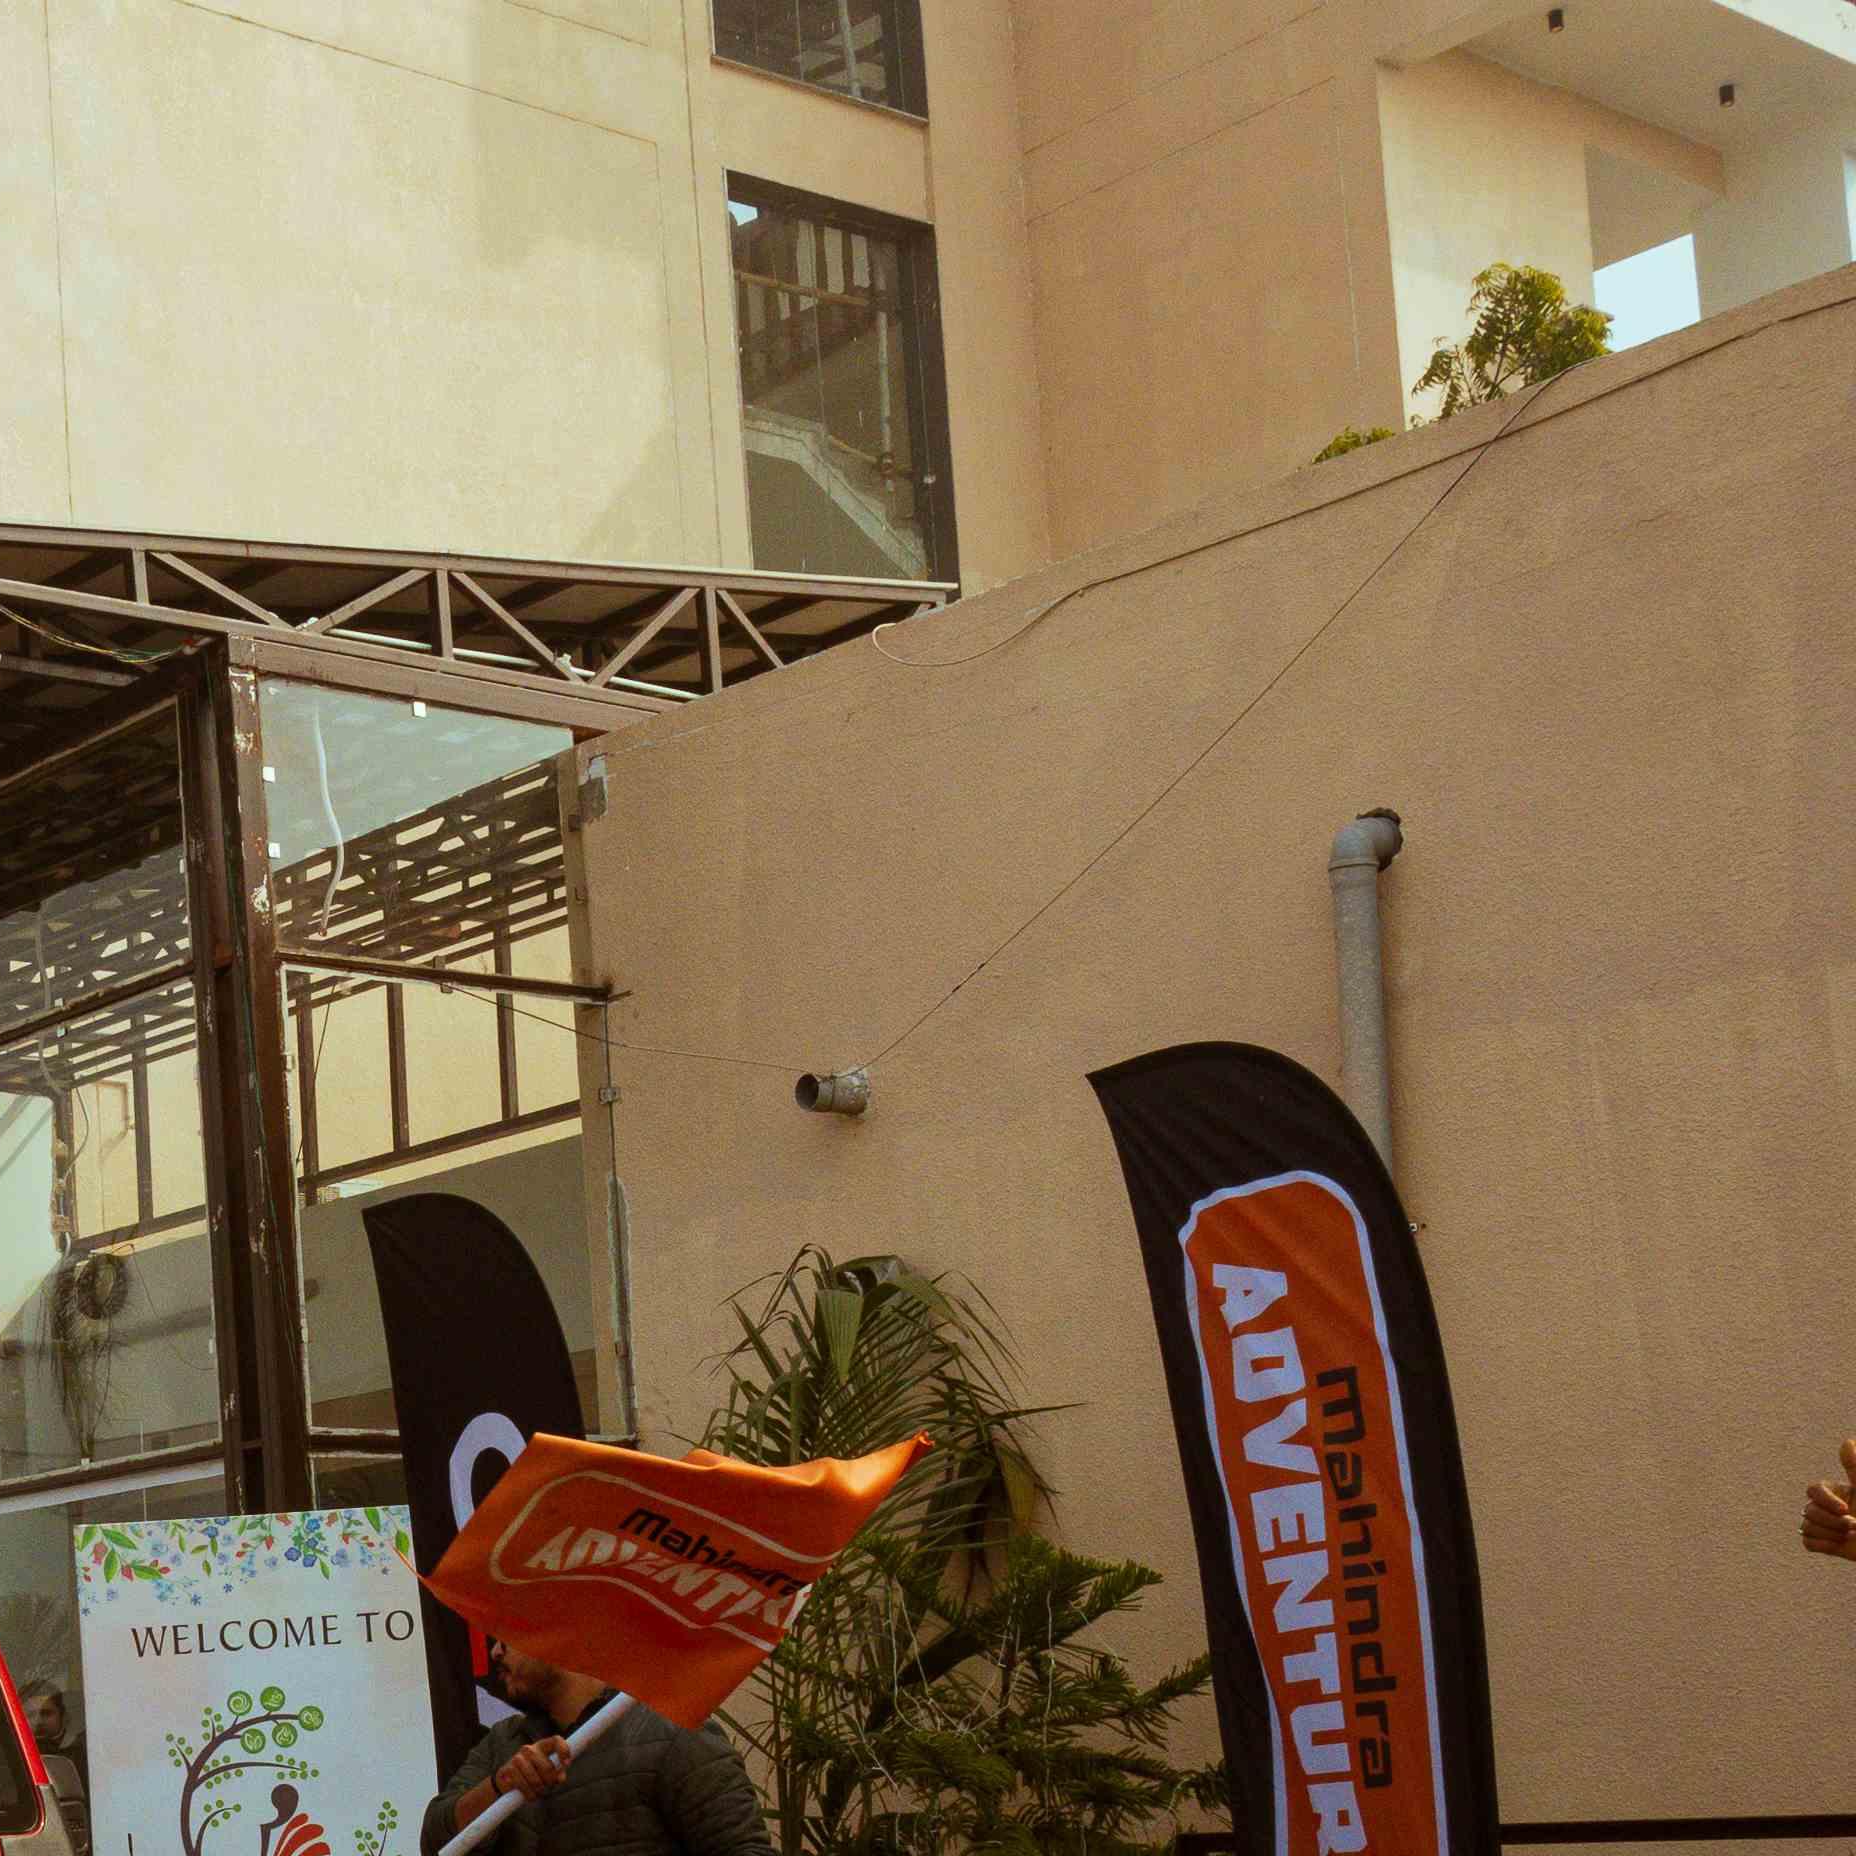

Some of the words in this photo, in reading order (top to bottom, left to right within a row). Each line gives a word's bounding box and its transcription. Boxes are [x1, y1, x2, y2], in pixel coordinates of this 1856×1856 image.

[130, 1613, 342, 1658] WELCOME
[356, 1609, 415, 1645] TO
[1315, 1365, 1398, 1789] mahindra
